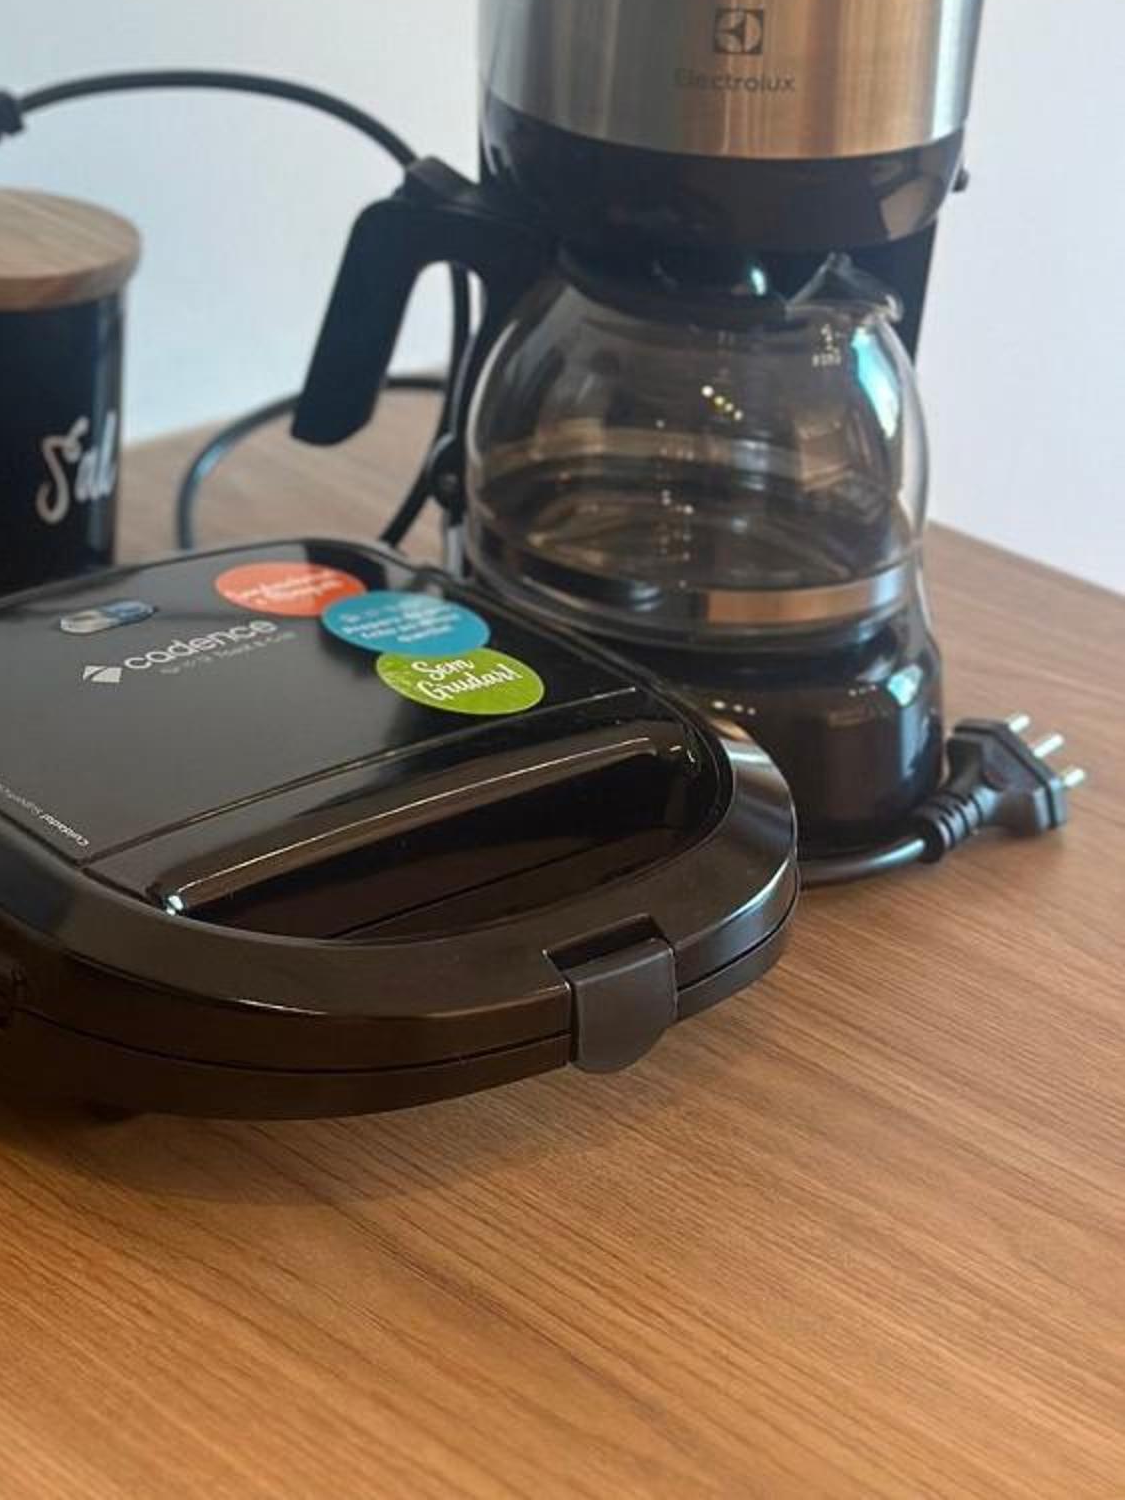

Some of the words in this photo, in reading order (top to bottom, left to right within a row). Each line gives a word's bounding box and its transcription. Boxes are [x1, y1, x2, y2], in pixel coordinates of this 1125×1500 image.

[36, 411, 117, 523] Sal
[124, 620, 278, 669] cadence
[411, 659, 475, 681] Sem
